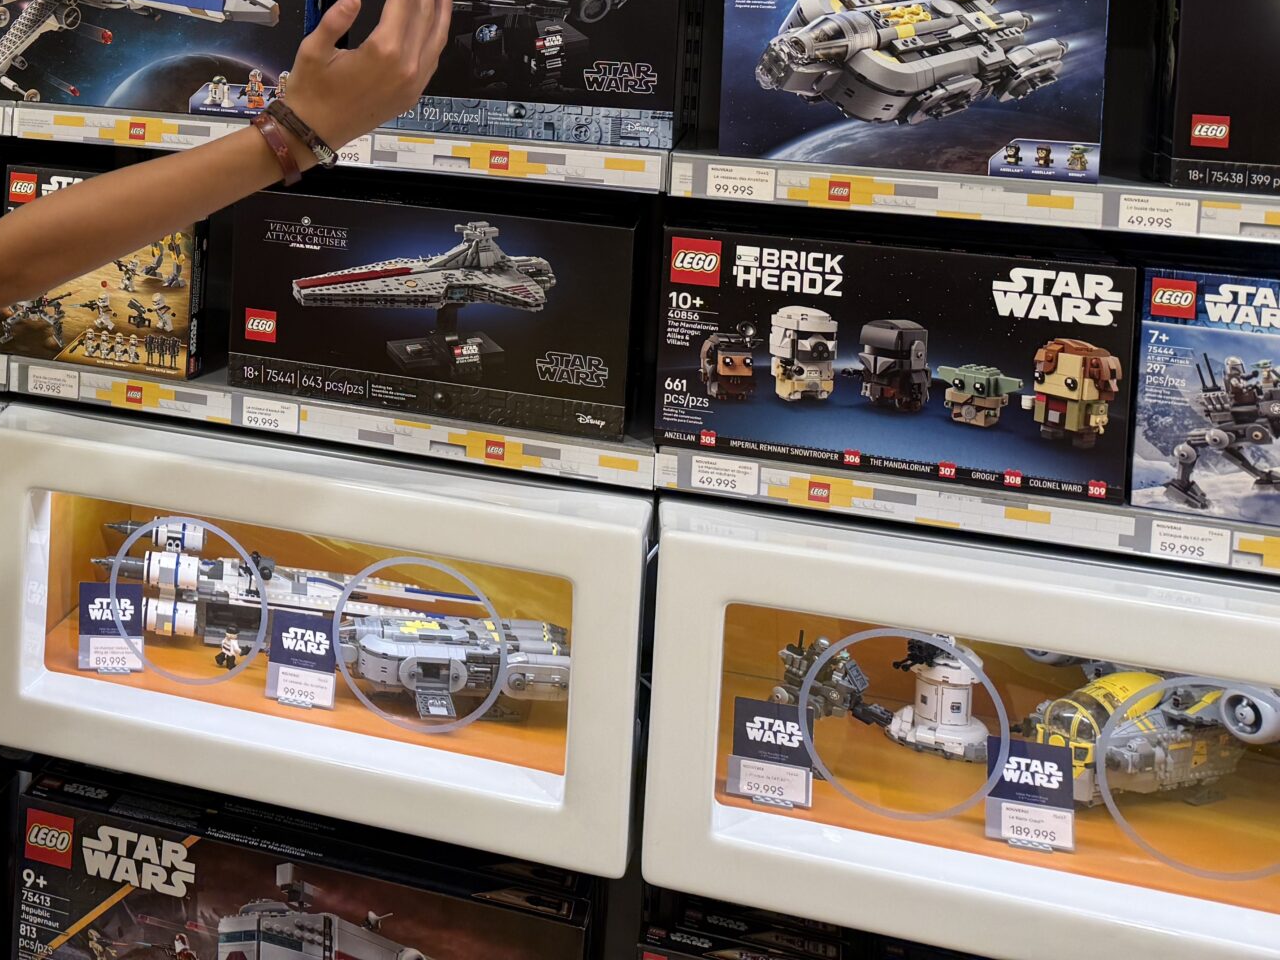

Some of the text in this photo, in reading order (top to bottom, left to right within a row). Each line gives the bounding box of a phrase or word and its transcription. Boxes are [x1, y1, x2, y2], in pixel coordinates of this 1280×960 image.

[10, 181, 37, 194] LEGO
[265, 231, 347, 247] ATTACK CRUISER
[270, 223, 348, 239] VENATOR-CLASS
[673, 251, 719, 272] LEGO
[762, 247, 844, 274] BRICK
[992, 267, 1123, 300] STAR
[668, 292, 704, 309] 10+
[1153, 288, 1194, 307] LEGO
[668, 309, 699, 320] 40856
[992, 291, 1123, 326] WARS
[246, 317, 275, 334] LEGO
[667, 338, 689, 346] Villains
[1148, 330, 1169, 343] 7+
[1148, 346, 1174, 355] 75444
[1147, 363, 1166, 373] 297
[664, 377, 687, 392] 661
[663, 392, 709, 408] pcs/pzs
[664, 431, 695, 441] ANZELLAN
[701, 435, 716, 444] 305
[730, 440, 839, 461] IMPERIAL REMNANT SNOWTROOPER
[844, 453, 860, 463] 306
[870, 458, 929, 473] THE MANDALORIAN
[939, 466, 956, 476] 307
[971, 471, 995, 482] GROGU
[1004, 474, 1021, 484] 308
[1029, 479, 1082, 493] COLONEL WARD
[1088, 485, 1106, 495] 309
[27, 822, 73, 852] LEGO
[81, 825, 196, 873] STAR
[22, 869, 48, 890] 9+
[81, 849, 196, 898] WARS
[21, 888, 51, 908] 75413
[20, 903, 51, 919] Republic
[20, 911, 60, 929] Juggernaut
